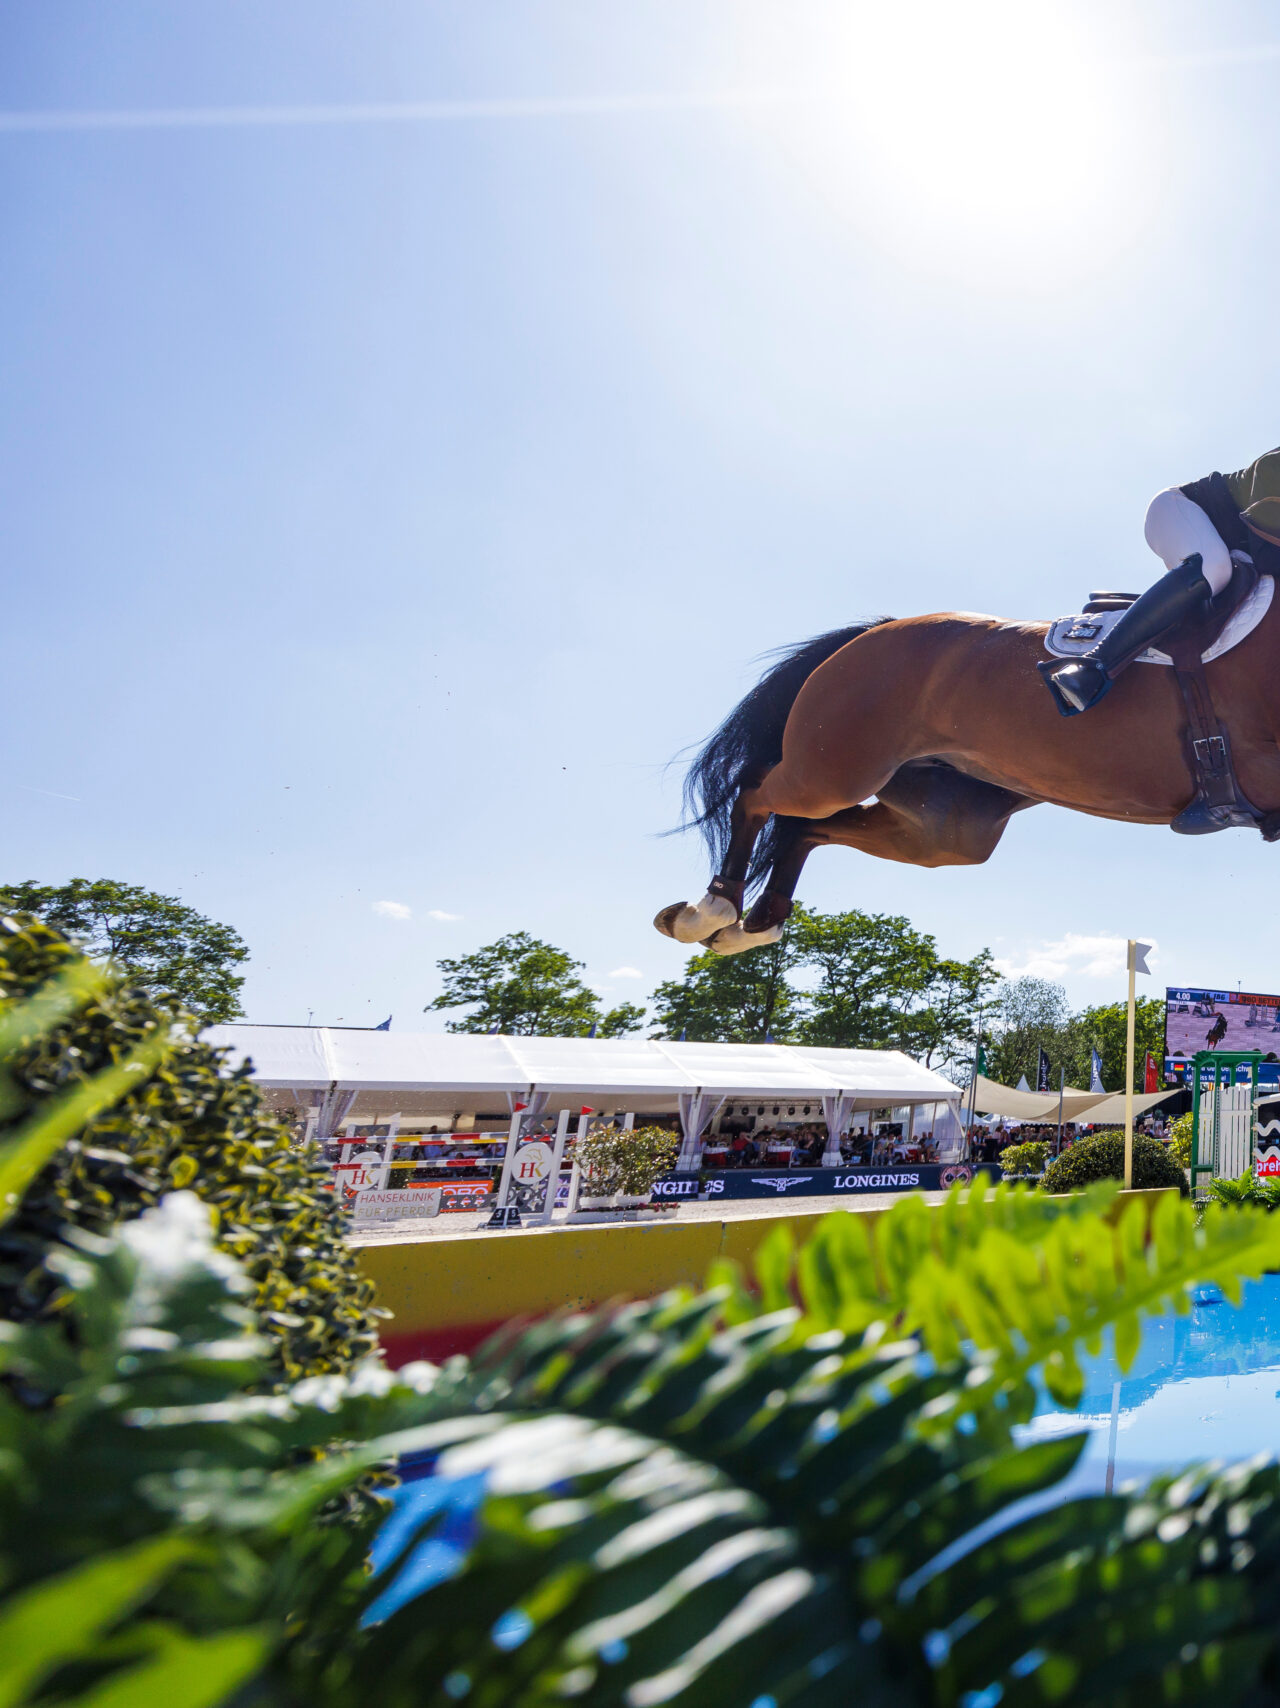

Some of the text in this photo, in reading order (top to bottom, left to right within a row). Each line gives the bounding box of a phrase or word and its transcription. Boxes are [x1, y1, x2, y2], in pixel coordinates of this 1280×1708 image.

[1176, 992, 1191, 1001] 4.00
[520, 1161, 545, 1178] HK
[833, 1173, 919, 1189] LONGINES
[360, 1191, 435, 1204] HANSEKLINIK
[358, 1205, 433, 1218] FÜR PFERDE
[495, 1209, 503, 1218] 5
[511, 1208, 517, 1218] 5
